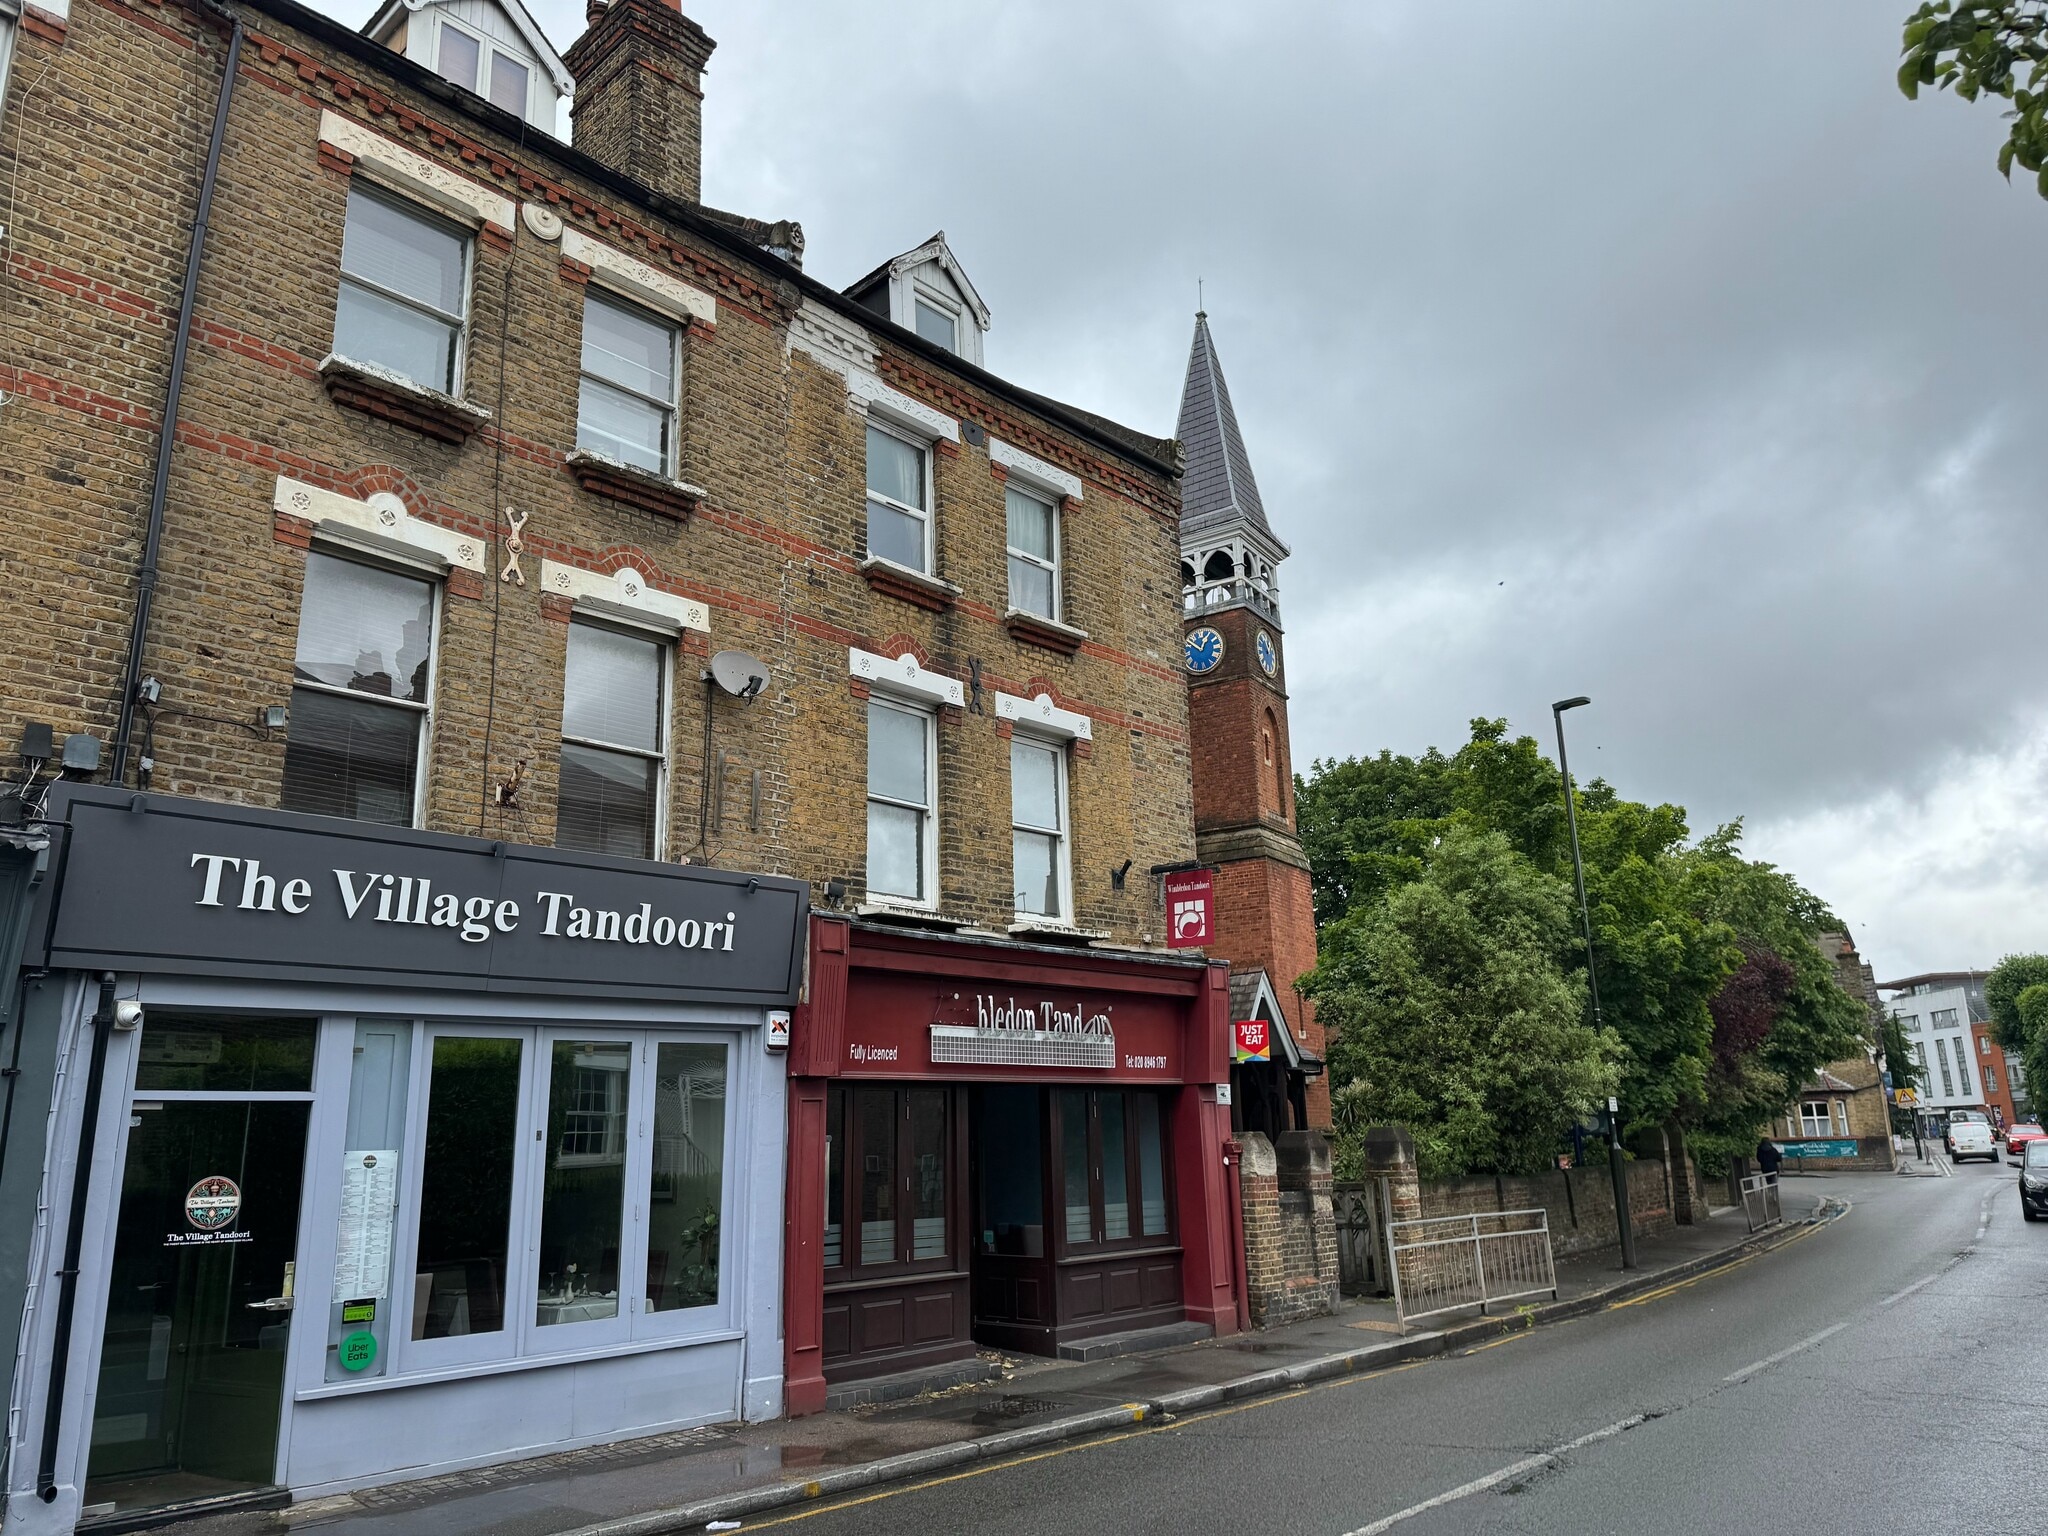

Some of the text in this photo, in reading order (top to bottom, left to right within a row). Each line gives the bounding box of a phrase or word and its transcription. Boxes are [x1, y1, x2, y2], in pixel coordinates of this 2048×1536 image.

[191, 853, 736, 951] The Village Tandoori
[1240, 1024, 1263, 1036] JUST
[1245, 1035, 1264, 1045] EAT
[850, 1044, 898, 1064] Fully Licenced
[167, 1233, 184, 1242] The
[185, 1232, 213, 1241] Village
[214, 1230, 250, 1239] Tandoori
[347, 1343, 369, 1352] Uber
[347, 1352, 368, 1361] Eats
